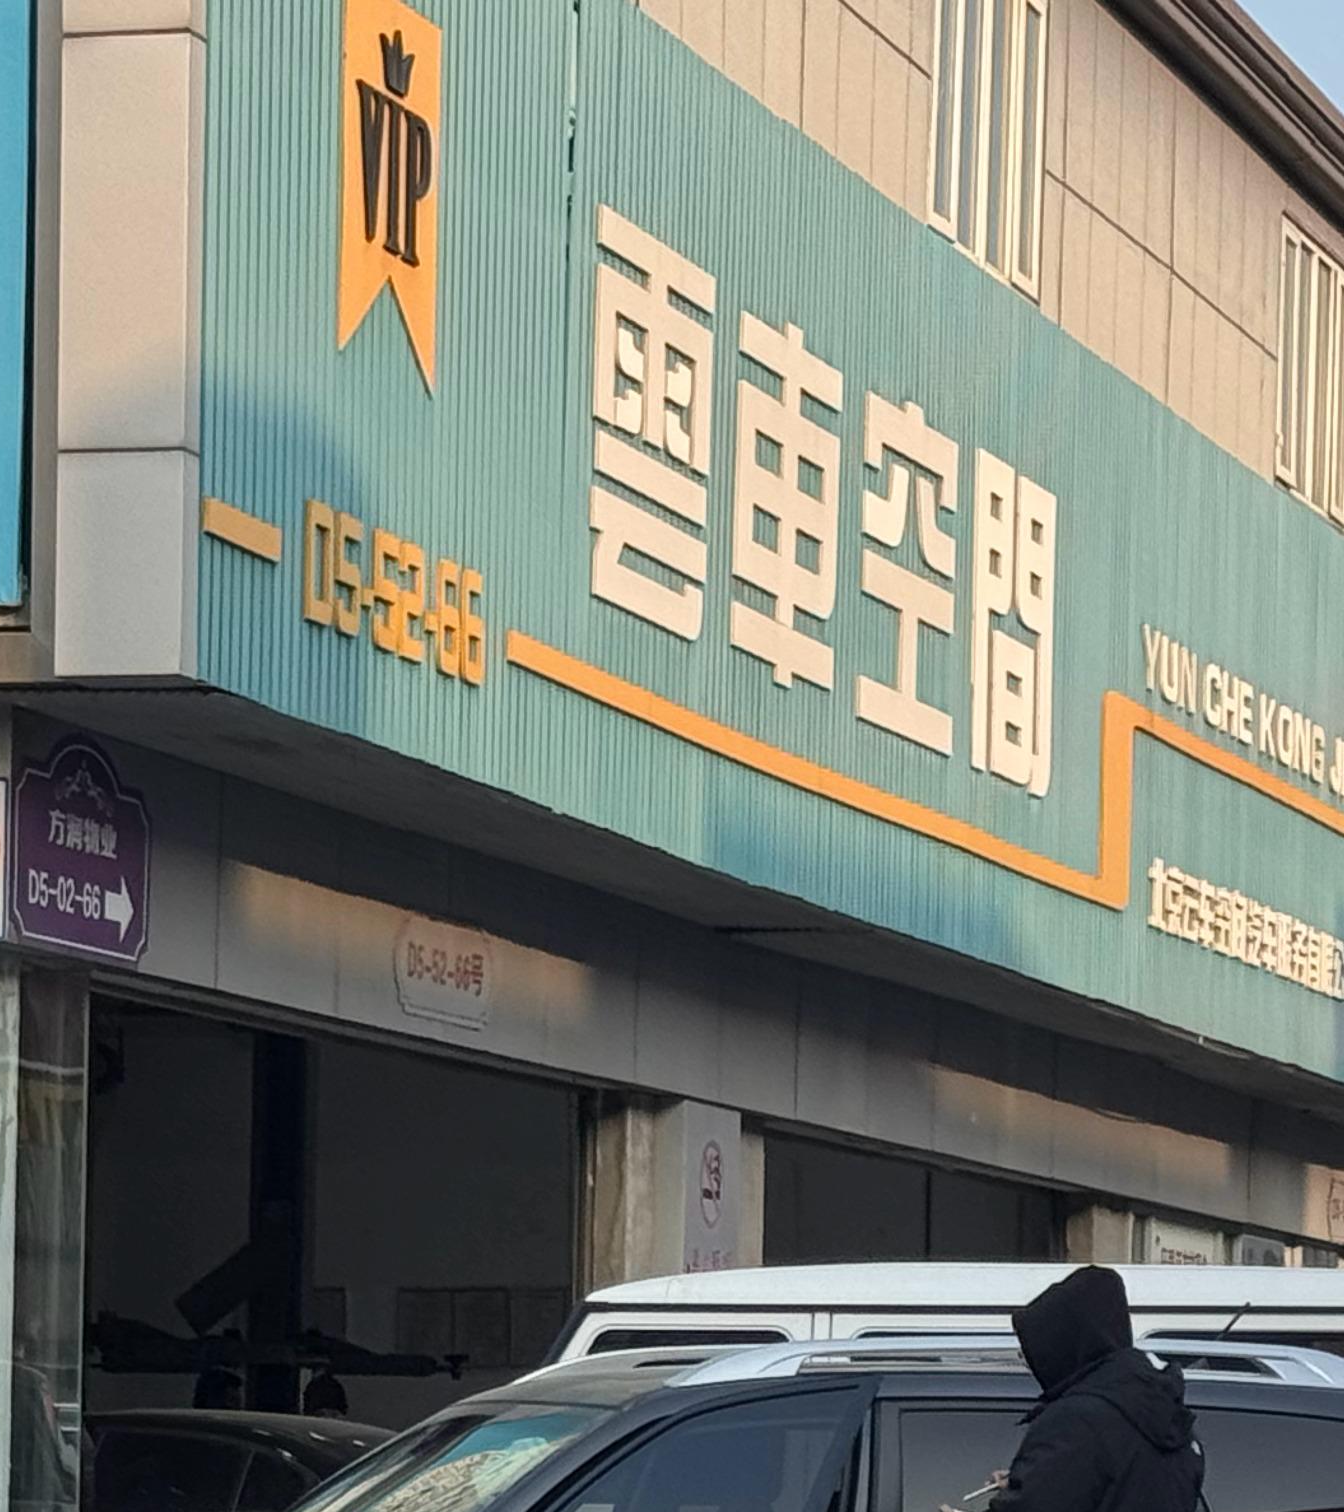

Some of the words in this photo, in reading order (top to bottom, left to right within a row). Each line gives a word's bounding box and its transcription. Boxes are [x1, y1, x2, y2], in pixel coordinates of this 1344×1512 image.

[358, 79, 433, 267] VIP
[591, 204, 1056, 799] 雲車空間
[1141, 623, 1198, 715] YUN
[1204, 662, 1254, 745] CHE
[1259, 692, 1325, 785] KONG
[27, 868, 102, 920] D5-02-66
